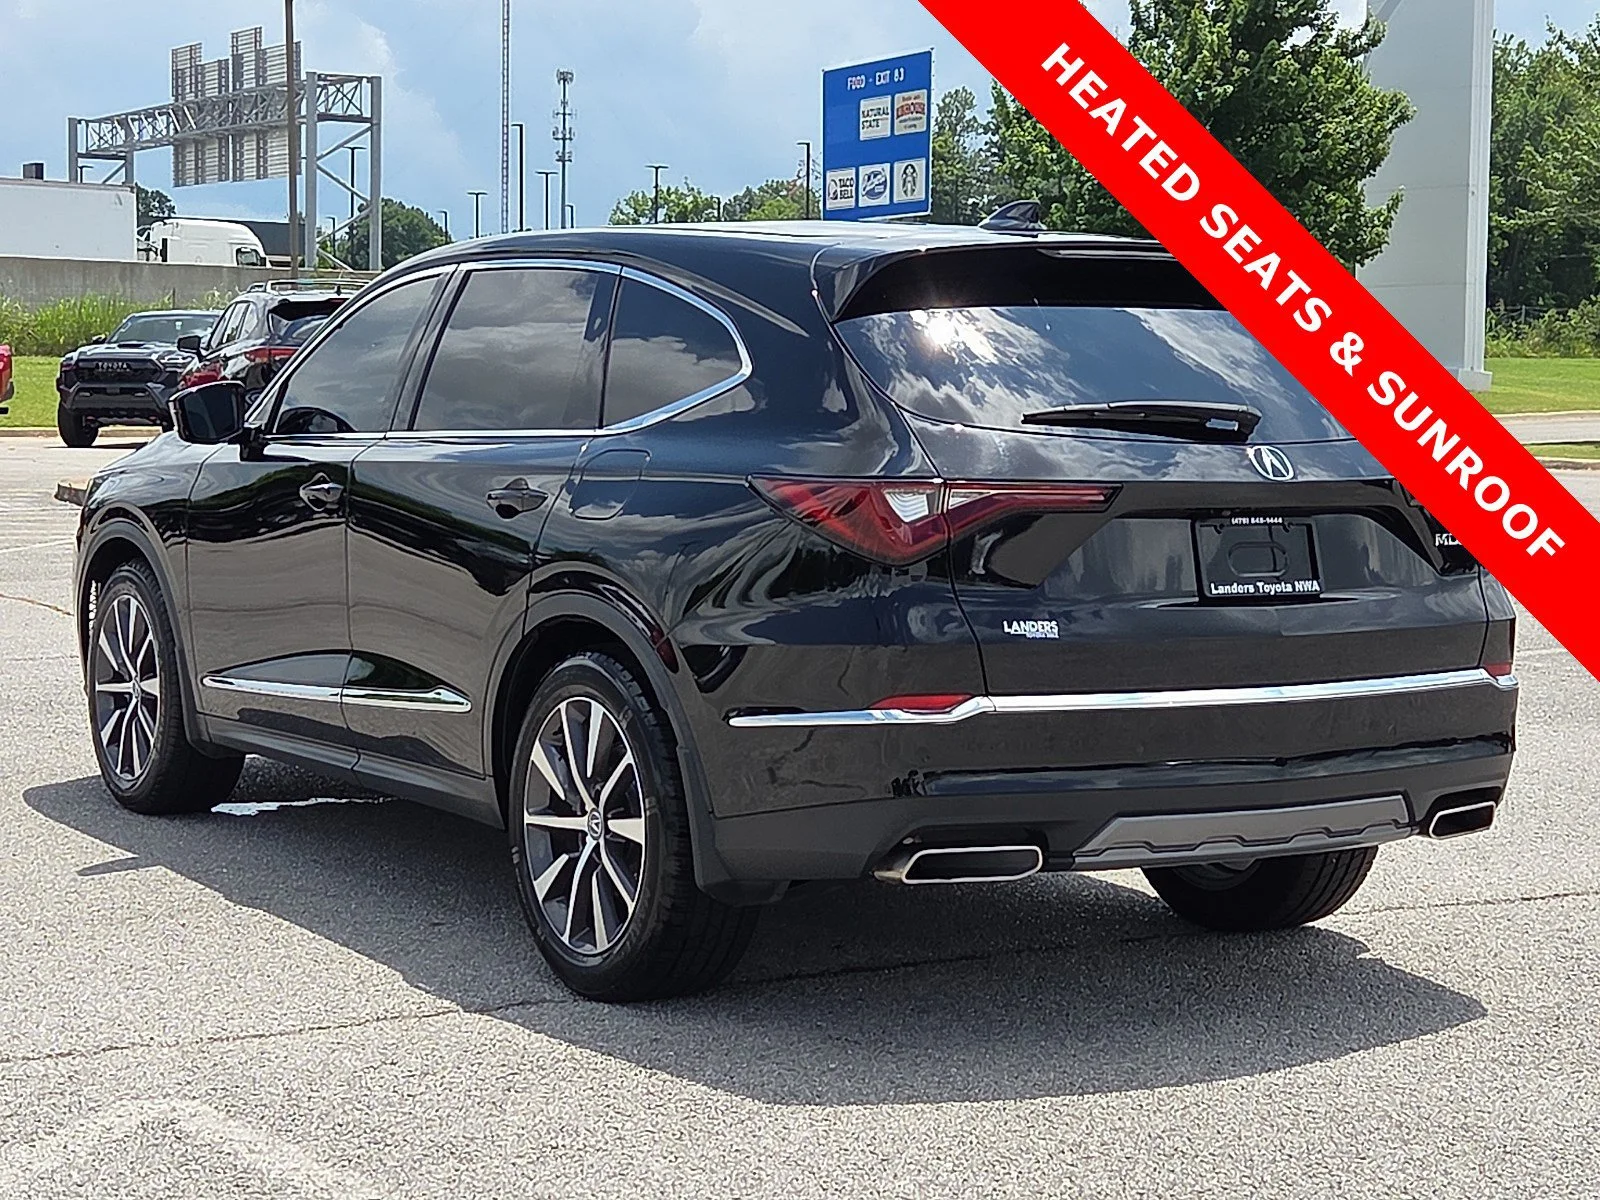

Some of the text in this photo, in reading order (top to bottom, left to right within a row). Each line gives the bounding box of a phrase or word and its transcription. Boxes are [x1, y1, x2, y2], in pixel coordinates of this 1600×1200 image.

[847, 75, 866, 90] FOOD
[875, 71, 891, 85] EXIT
[862, 106, 889, 118] NATURAL
[862, 119, 880, 130] STATE
[838, 177, 854, 188] TACO
[839, 188, 854, 199] BELL
[98, 361, 130, 372] TOYOTA
[1210, 580, 1320, 595] Landers Toyota NWA
[1003, 620, 1059, 634] LANDERS
